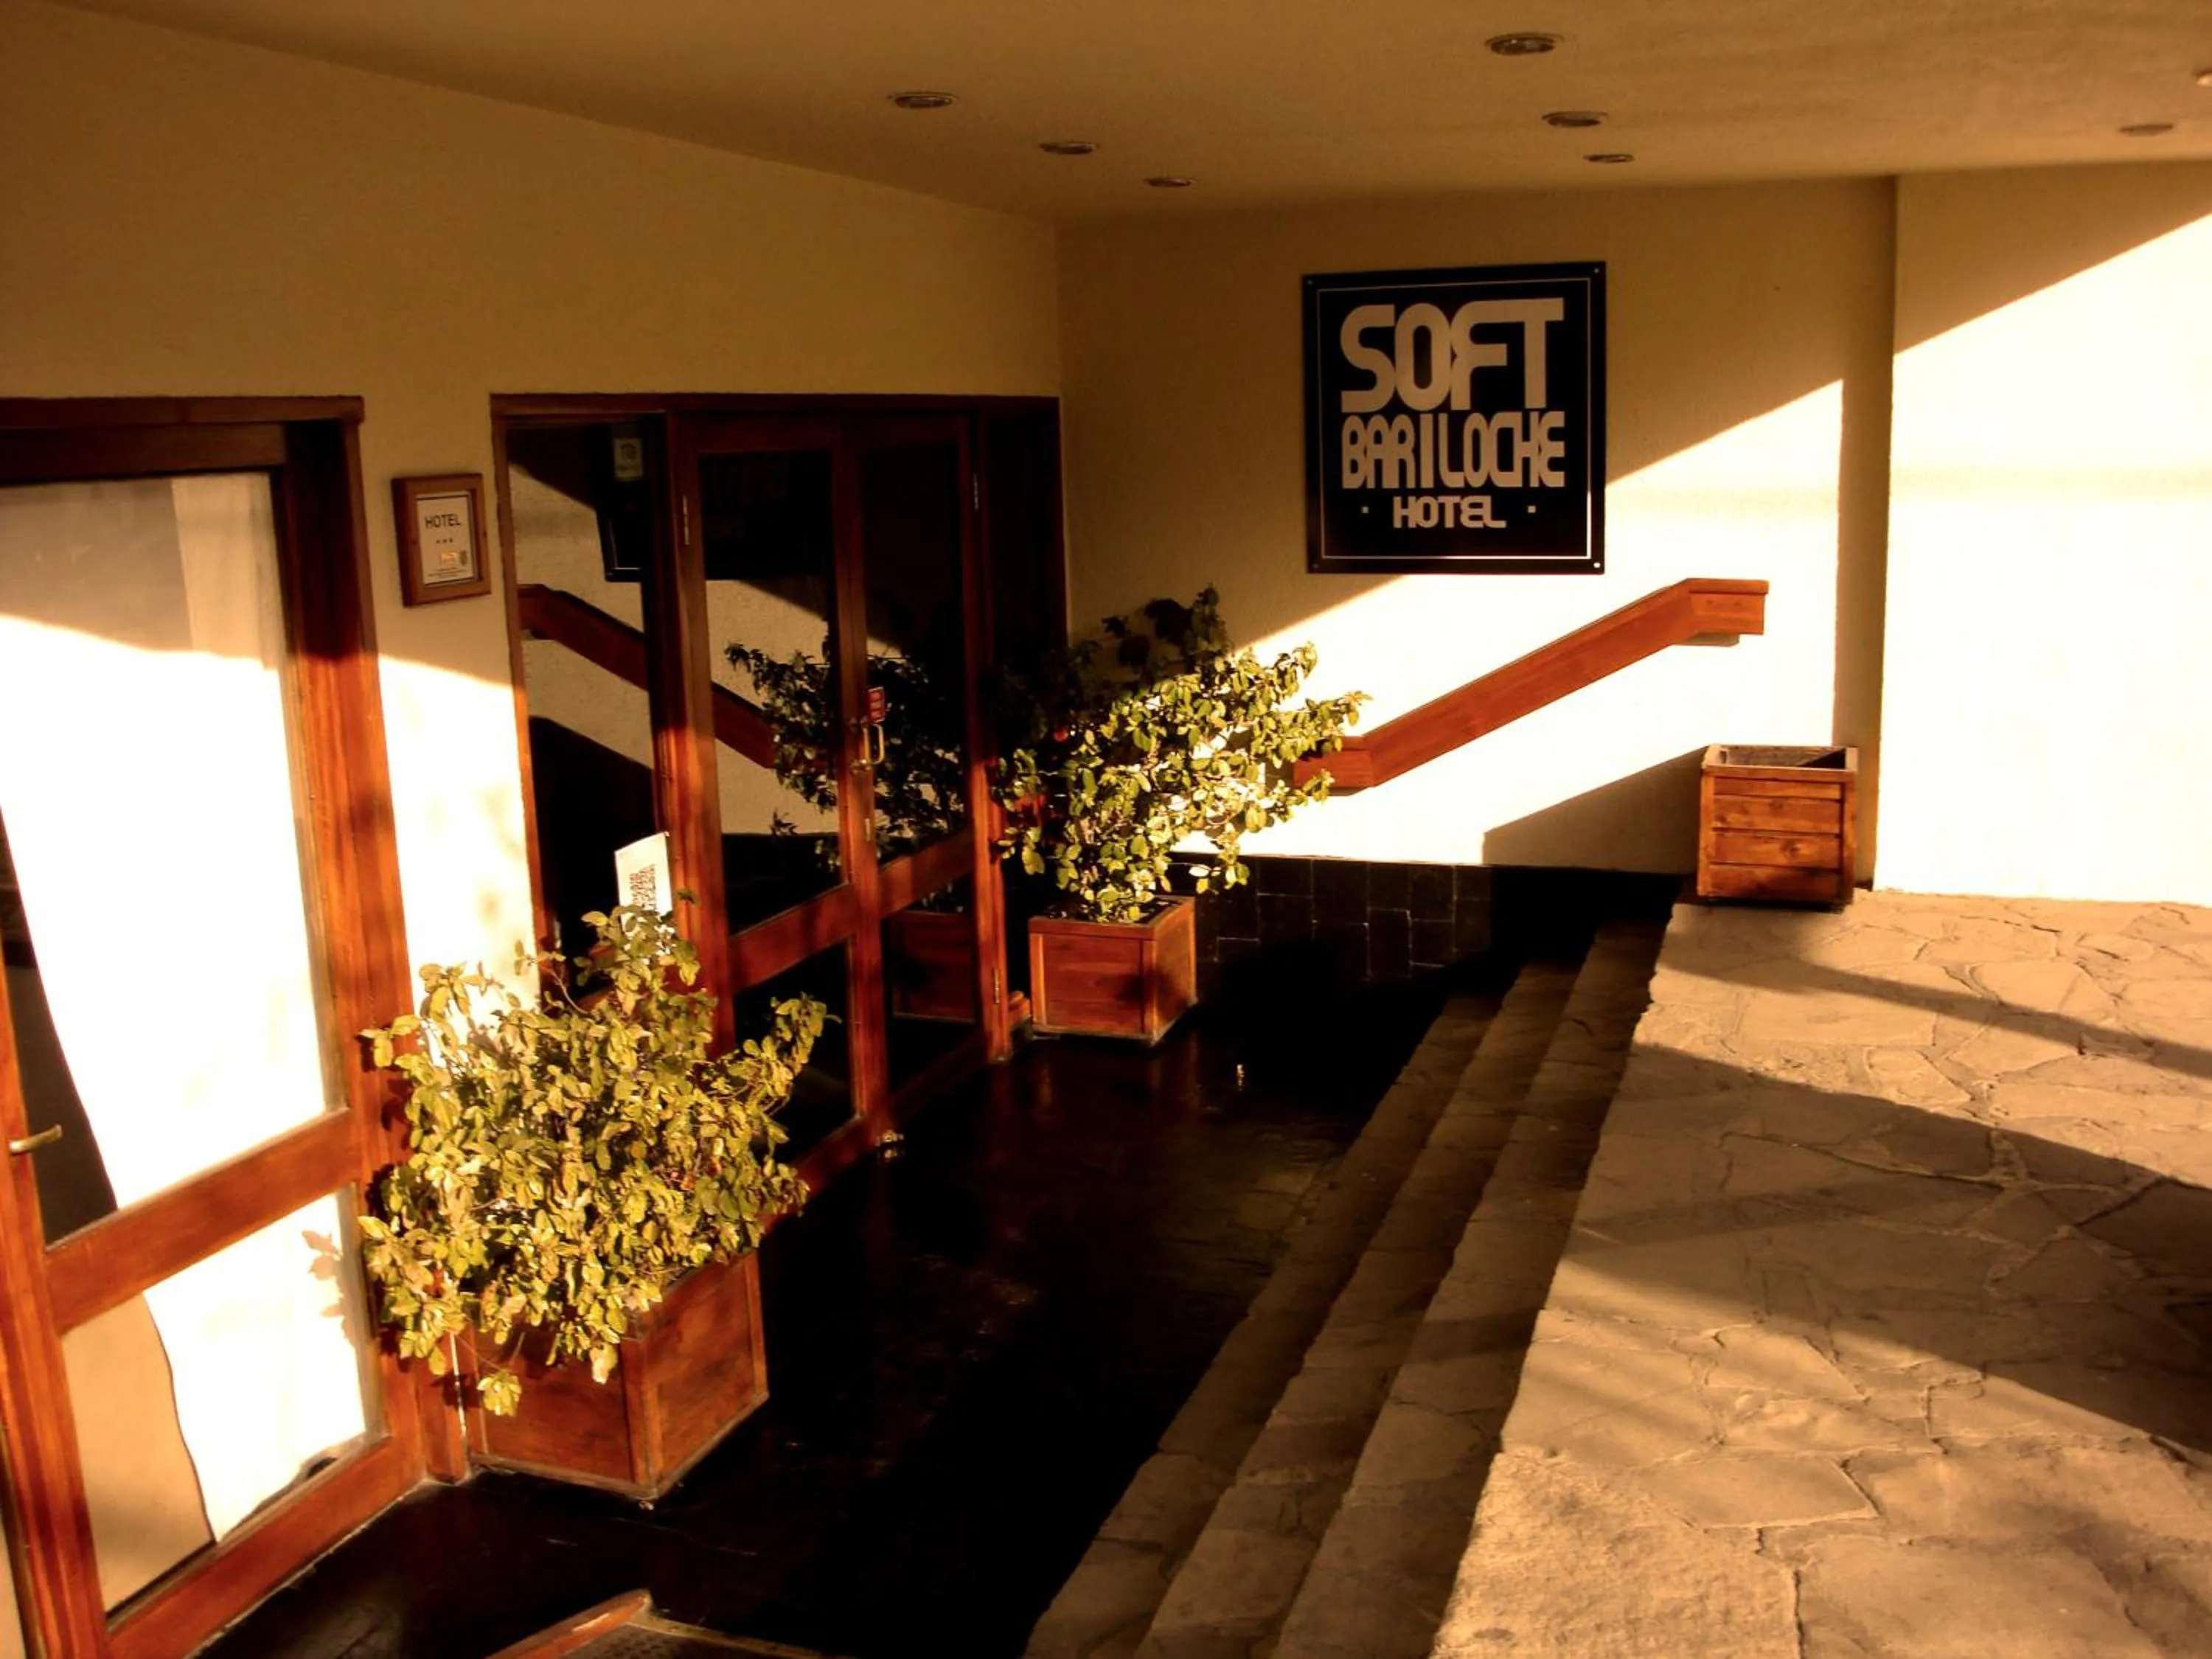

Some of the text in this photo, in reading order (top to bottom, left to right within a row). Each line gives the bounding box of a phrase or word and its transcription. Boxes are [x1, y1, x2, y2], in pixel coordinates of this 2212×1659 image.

[1340, 298, 1564, 412] SOFT
[1342, 411, 1565, 489] BARILOCHE
[425, 514, 461, 529] HOTEL
[1393, 495, 1506, 529] HOTEL
